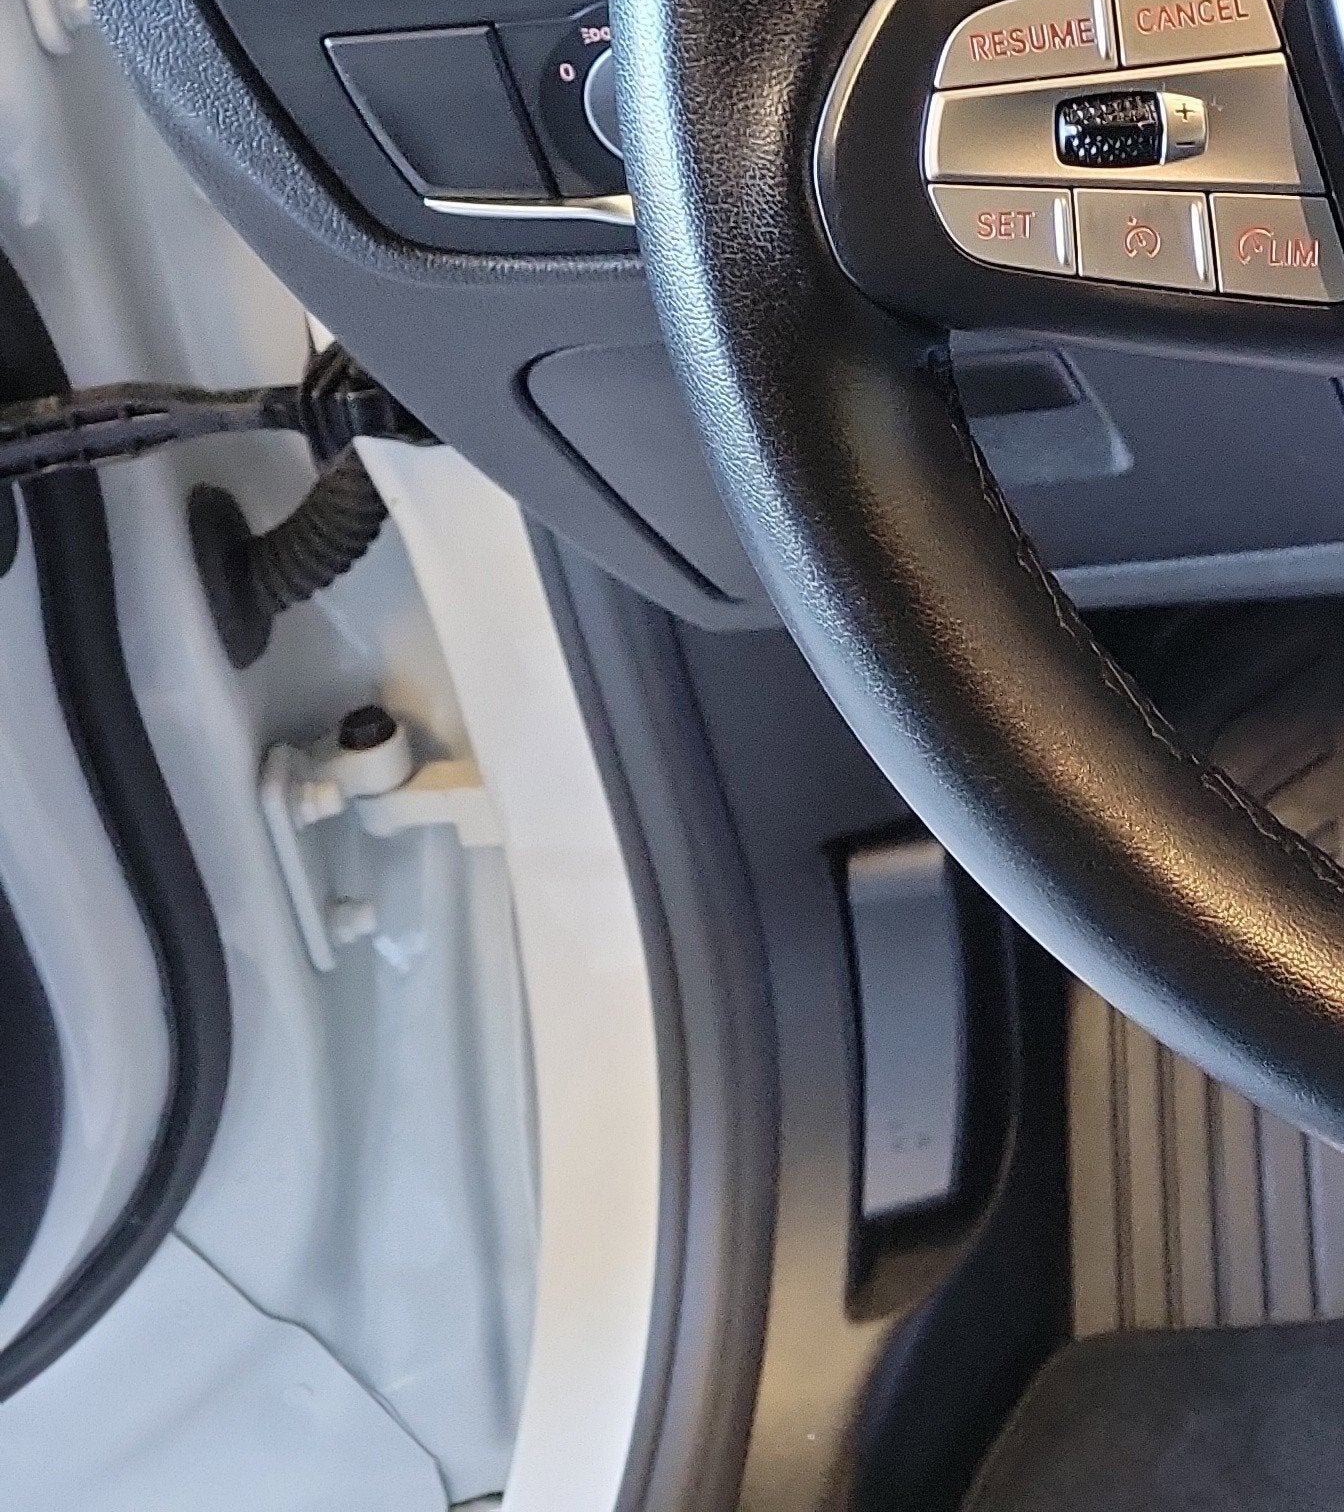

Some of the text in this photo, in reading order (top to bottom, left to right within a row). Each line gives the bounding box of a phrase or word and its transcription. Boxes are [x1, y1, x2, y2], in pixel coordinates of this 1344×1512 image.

[968, 16, 1096, 61] RESUME
[975, 210, 1036, 241] SET
[1267, 236, 1321, 268] LIM
